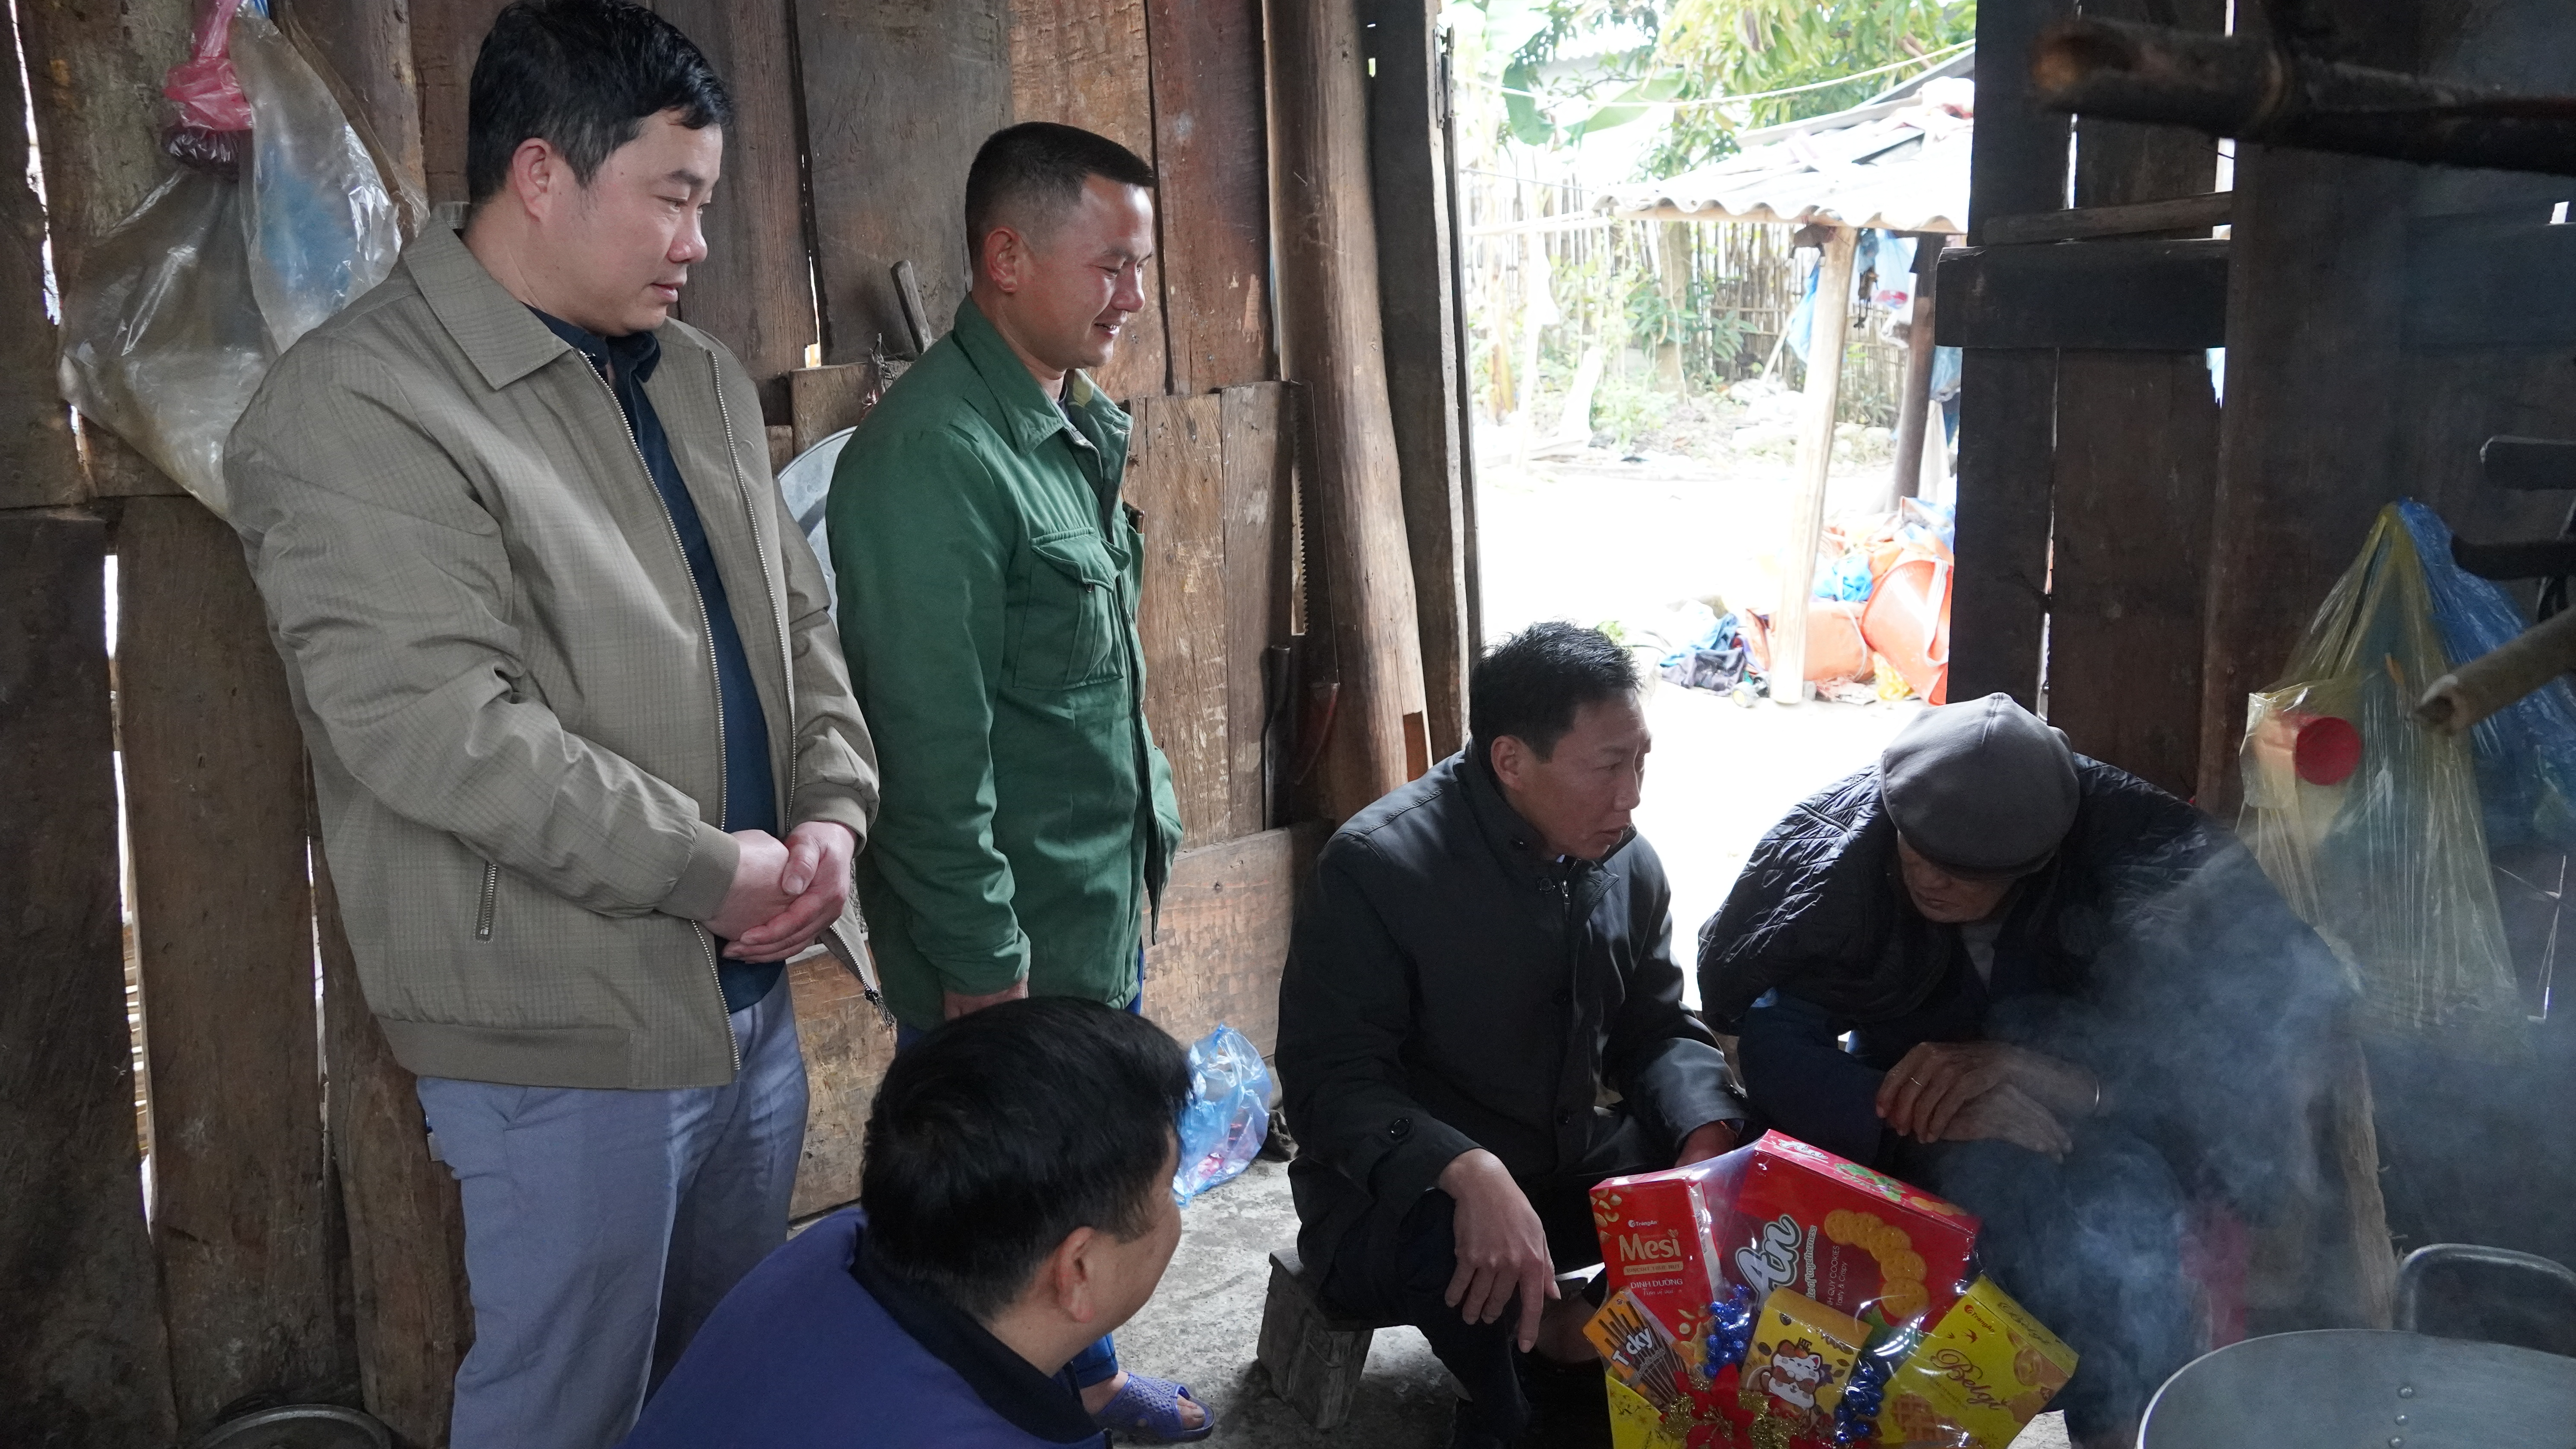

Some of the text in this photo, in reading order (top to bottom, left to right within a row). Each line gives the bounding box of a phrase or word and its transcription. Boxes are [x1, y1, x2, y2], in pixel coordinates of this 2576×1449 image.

[1619, 1229, 1681, 1262] Mesi
[1804, 1225, 1817, 1278] togetherness
[1830, 1245, 1840, 1279] COOKIES
[1805, 1277, 1817, 1288] of
[1838, 1261, 1849, 1282] Crispy
[1836, 1290, 1844, 1306] Tasty
[1930, 1348, 2009, 1410] Belgi
